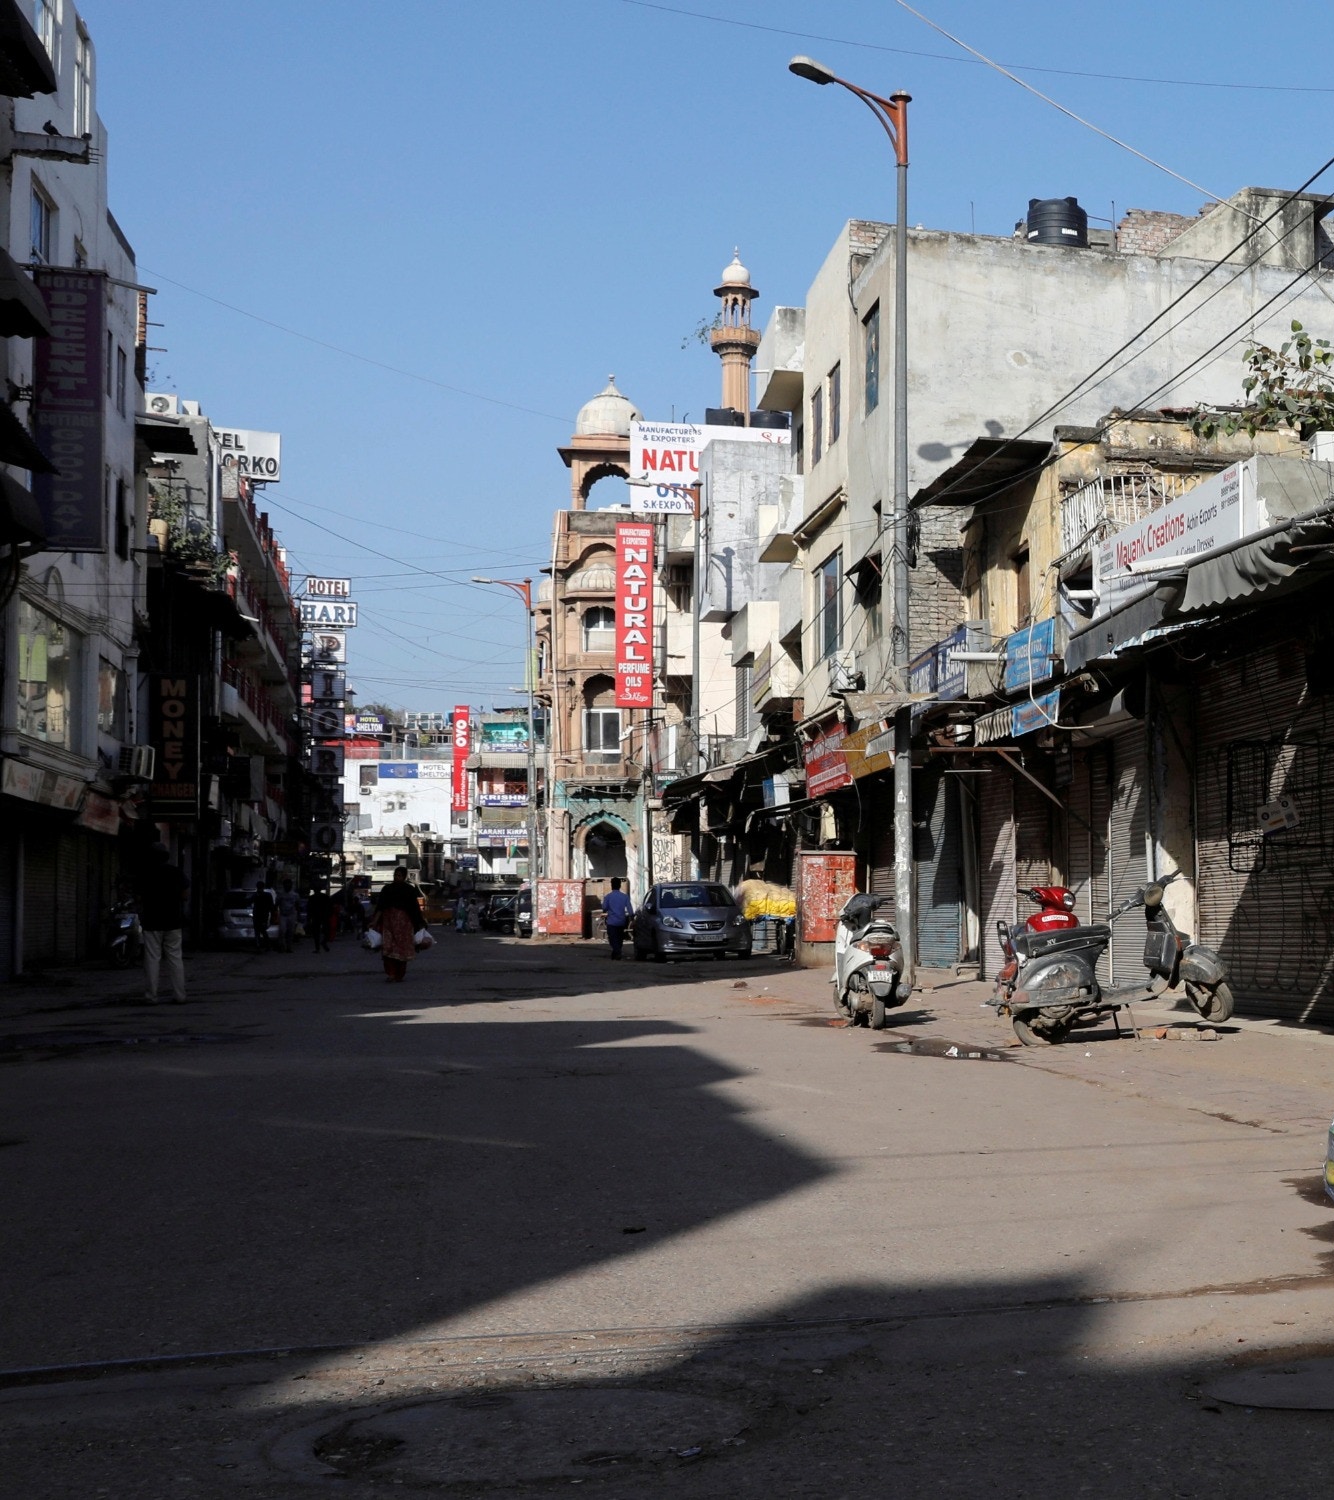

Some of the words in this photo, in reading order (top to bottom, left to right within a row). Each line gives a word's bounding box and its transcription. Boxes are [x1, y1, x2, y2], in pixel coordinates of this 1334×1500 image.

[39, 275, 96, 290] HOTEL
[48, 291, 88, 390] DECENT
[39, 412, 97, 427] COTTAGE
[638, 427, 702, 436] MANUFACTURERS
[50, 429, 85, 482] GOOD
[52, 490, 84, 529] DAY
[1147, 513, 1184, 552] Creations
[1200, 503, 1217, 526] Exports
[308, 580, 348, 596] HOTEL
[623, 548, 648, 661] NATURAL
[301, 604, 355, 624] HARI
[618, 663, 650, 674] PERFUME
[625, 676, 642, 687] OILS
[160, 678, 187, 781] MONEY
[357, 723, 383, 732] SHELTON
[455, 719, 468, 747] OYO
[150, 783, 196, 798] CHANGER
